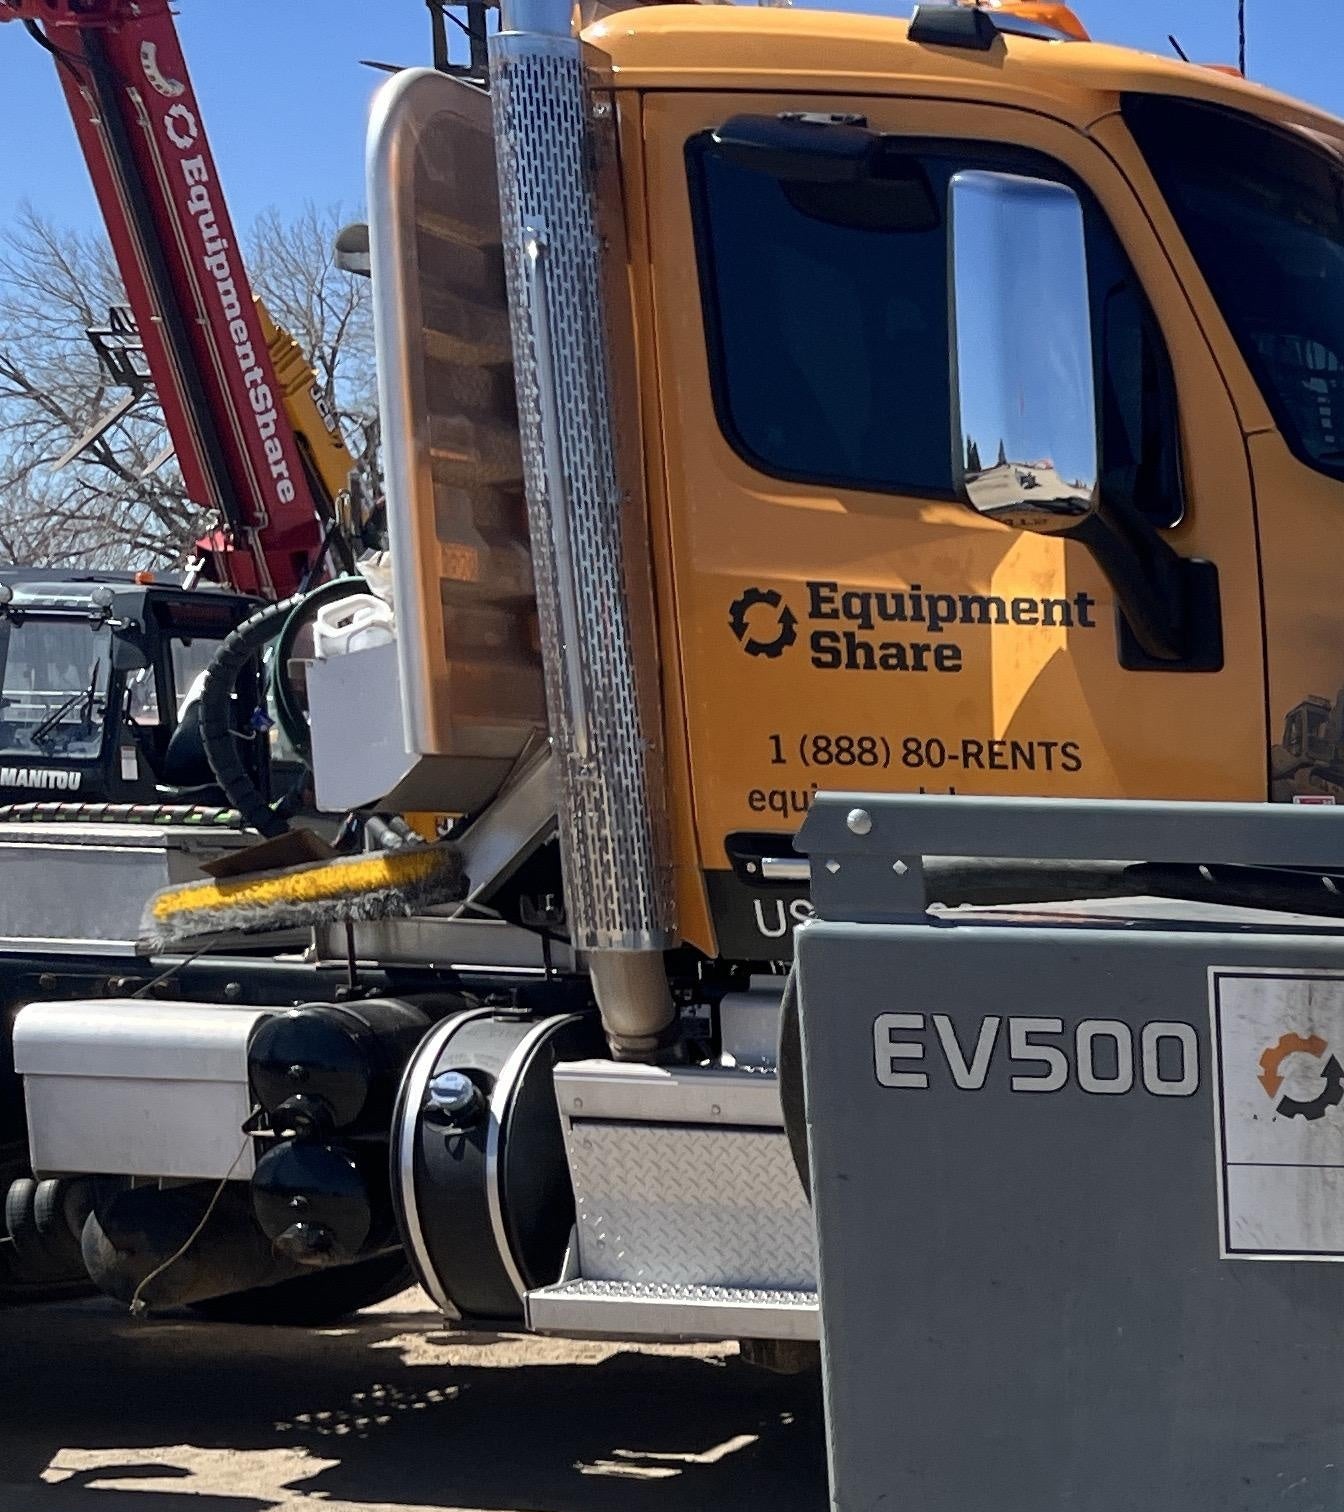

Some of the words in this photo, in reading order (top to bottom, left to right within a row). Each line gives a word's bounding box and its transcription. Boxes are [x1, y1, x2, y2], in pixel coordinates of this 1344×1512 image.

[180, 154, 296, 505] EquipmentShare
[806, 580, 1096, 633] Equipment
[810, 630, 963, 673] Share
[768, 734, 787, 765] 1
[799, 734, 891, 769] (888)
[901, 736, 1083, 773] 80-RENTS
[0, 767, 82, 791] MANITOU
[872, 1011, 1200, 1097] EV500
